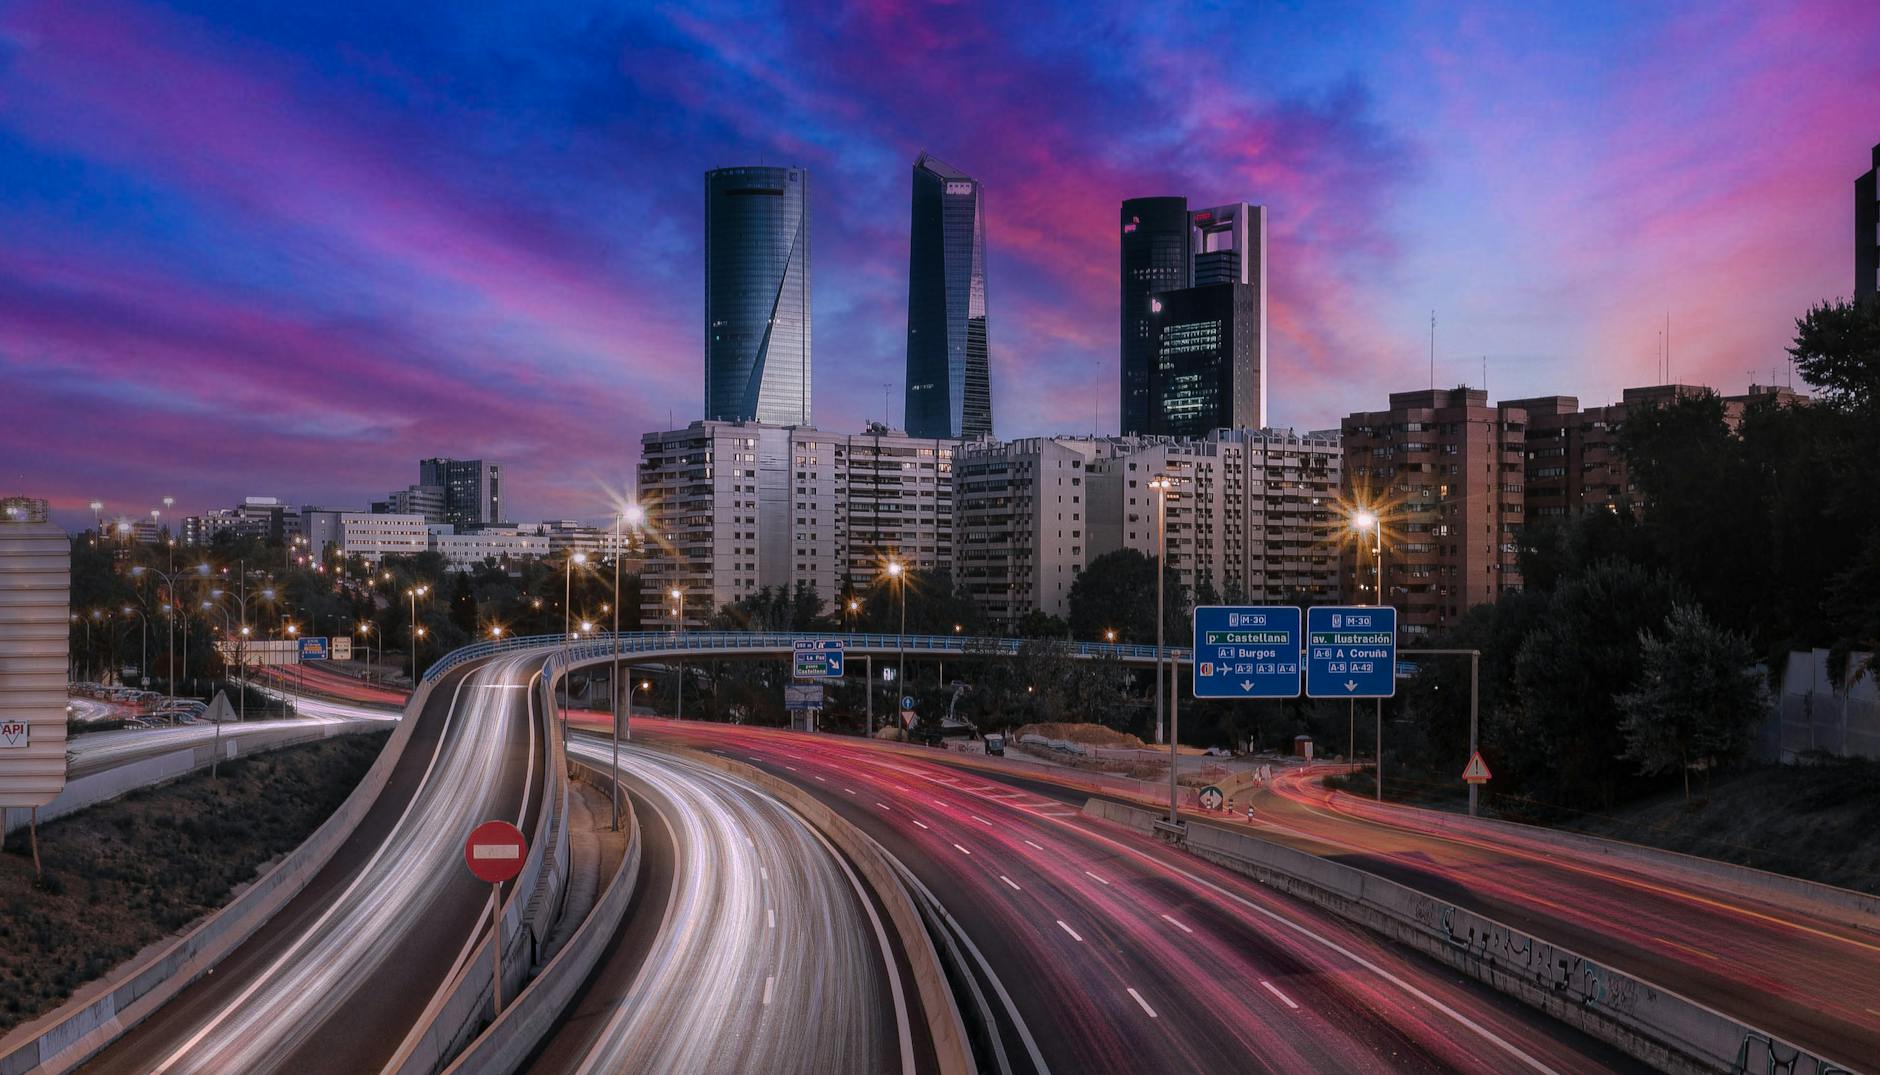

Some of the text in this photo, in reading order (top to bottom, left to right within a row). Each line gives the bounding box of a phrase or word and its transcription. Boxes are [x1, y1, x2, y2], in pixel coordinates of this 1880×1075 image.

[1242, 616, 1265, 624] M-30
[1347, 617, 1370, 625] M-30
[1226, 633, 1287, 643] Castellana
[1312, 633, 1390, 644] av. Ilustración
[1220, 648, 1276, 659] A-1 Burgos
[1336, 648, 1344, 658] A
[1349, 648, 1388, 658] Coruña
[1237, 665, 1295, 673] A-2 A-3 A-4
[2, 724, 24, 735] API
